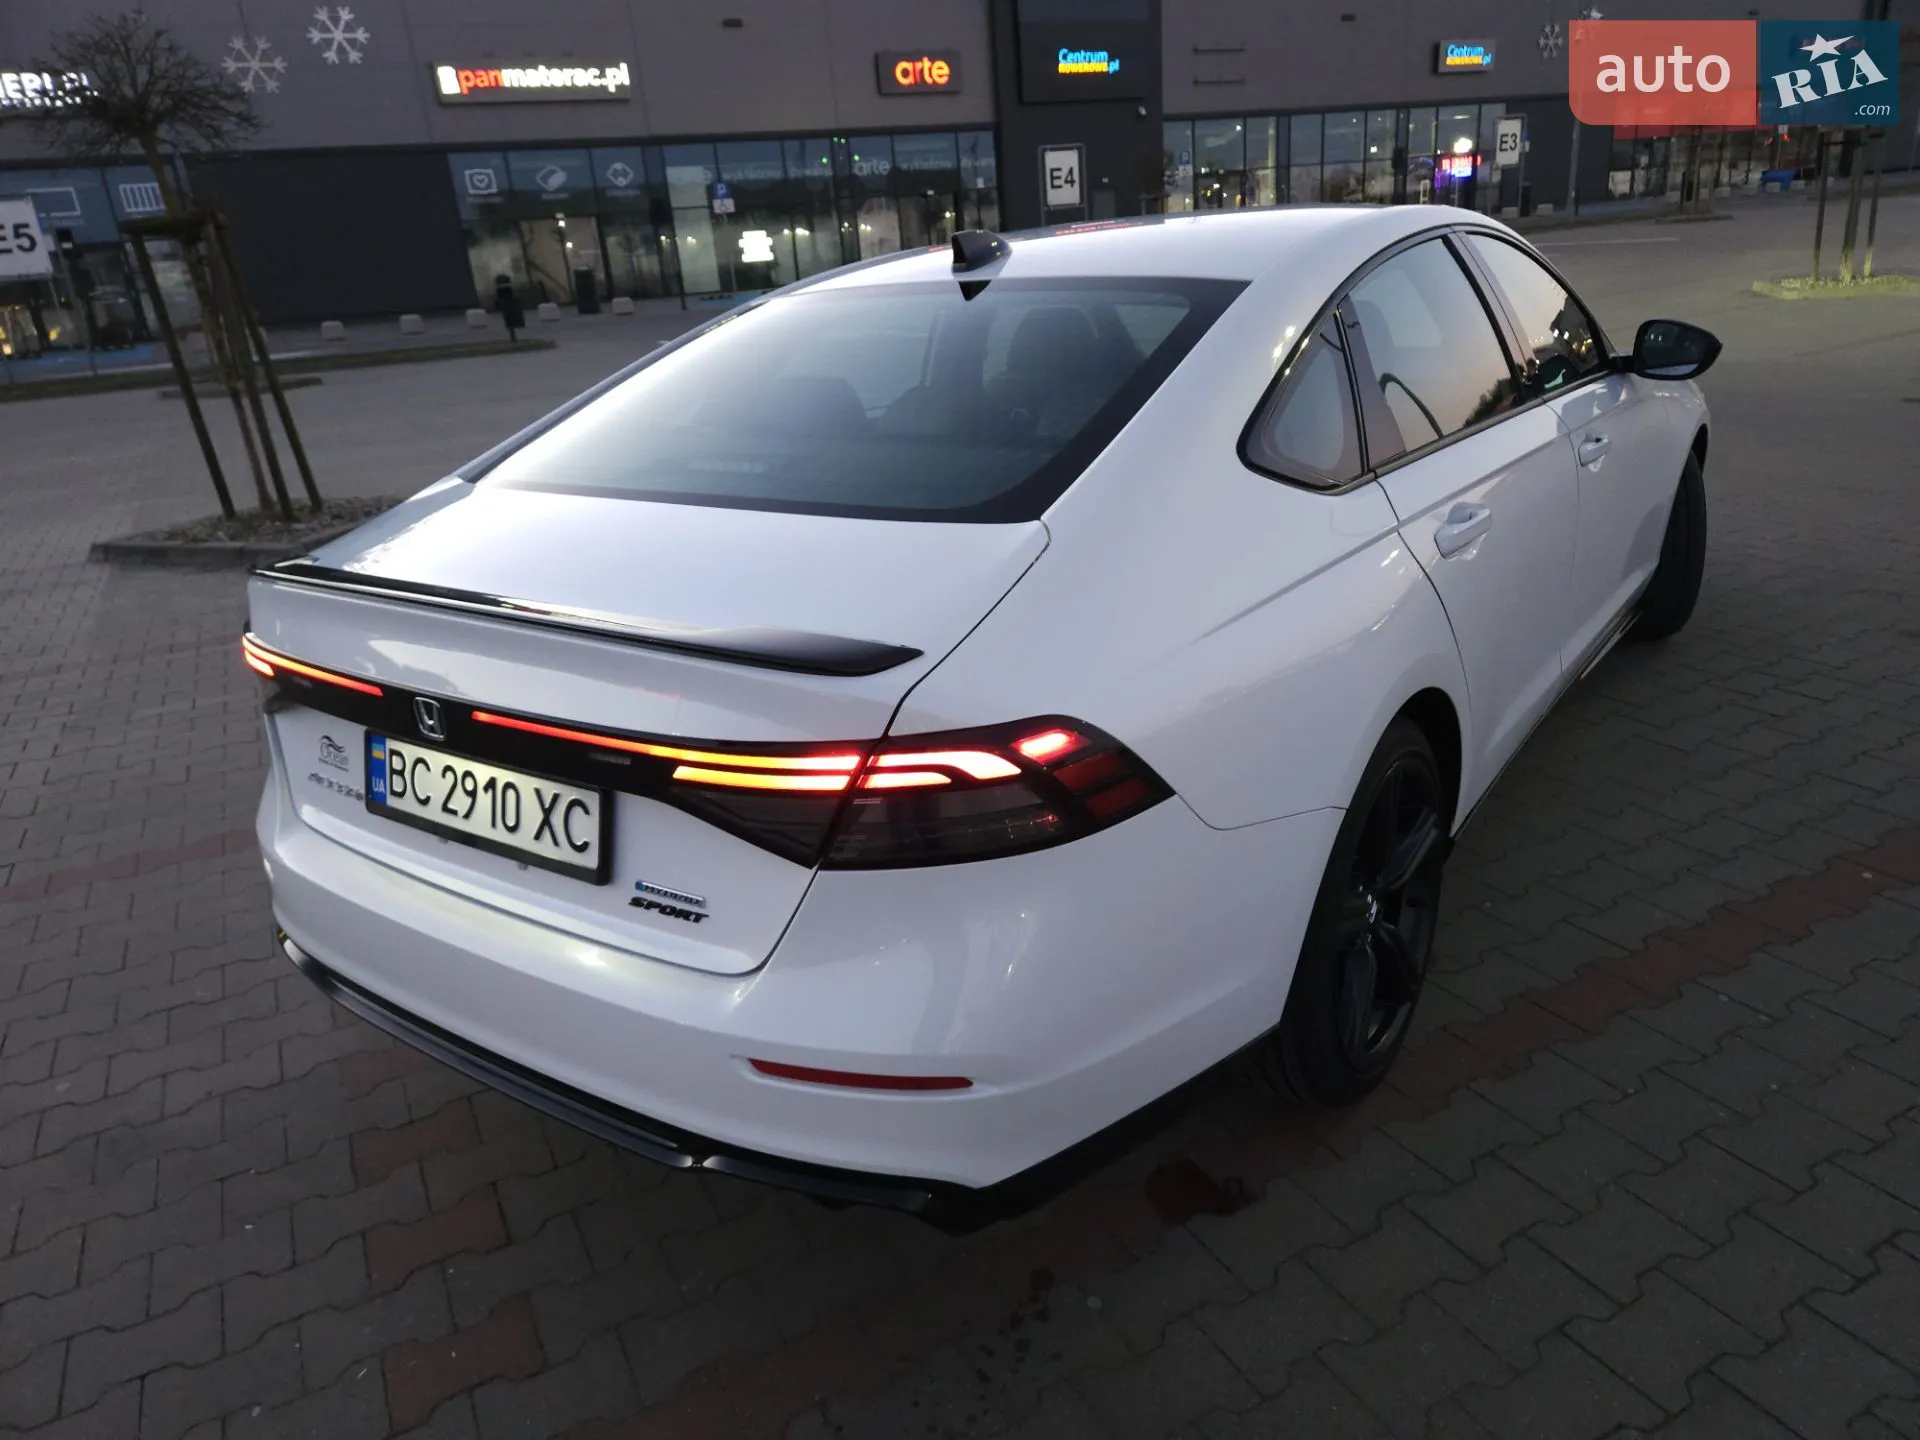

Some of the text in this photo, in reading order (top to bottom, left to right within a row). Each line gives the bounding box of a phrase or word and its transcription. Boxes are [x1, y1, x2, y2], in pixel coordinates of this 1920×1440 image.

[1058, 48, 1109, 63] Centrum
[1447, 44, 1484, 58] Centrum
[895, 56, 951, 86] arte
[1499, 132, 1518, 152] E3
[1050, 166, 1077, 190] E4
[371, 775, 386, 794] UA
[389, 747, 432, 806] BC
[441, 764, 521, 833] 2910
[533, 786, 591, 854] XC
[628, 896, 710, 924] SPORT
